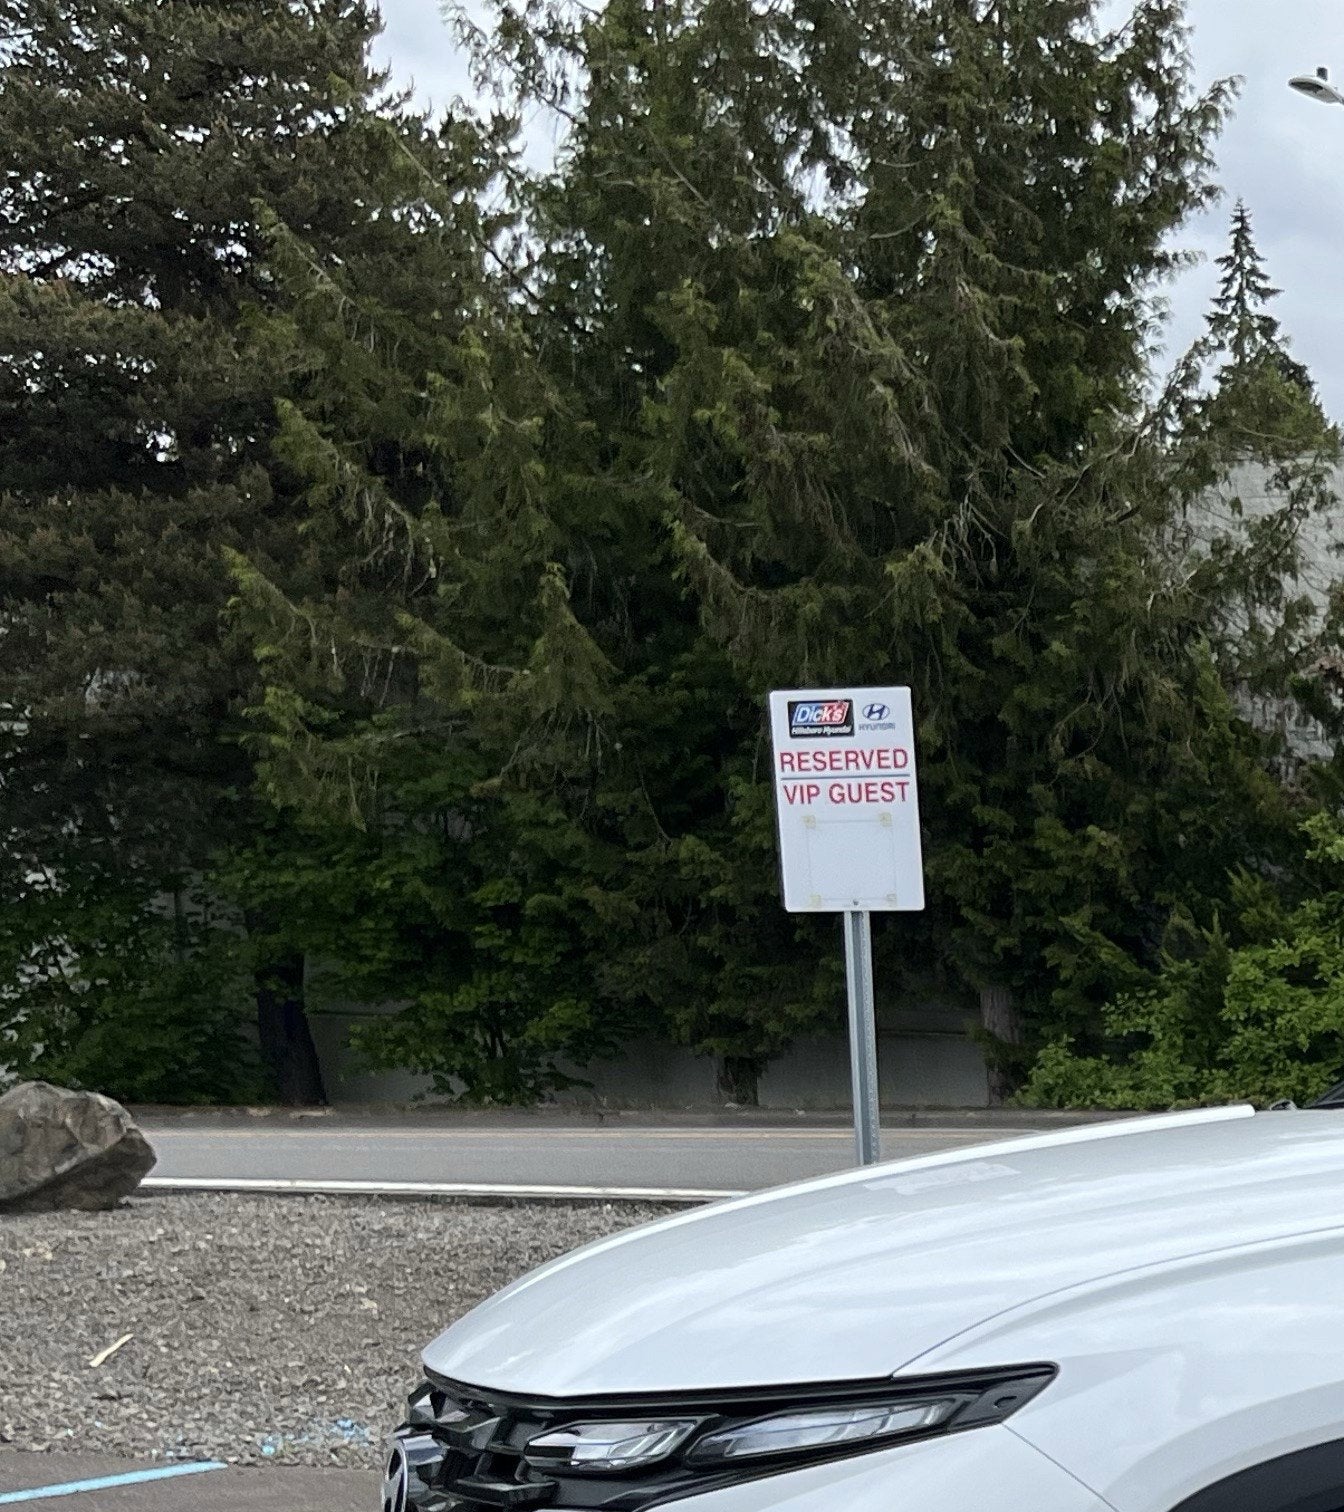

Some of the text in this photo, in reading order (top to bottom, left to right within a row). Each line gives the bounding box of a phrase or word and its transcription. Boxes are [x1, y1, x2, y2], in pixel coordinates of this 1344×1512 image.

[780, 748, 909, 772] RESERVED
[783, 781, 910, 805] VIP GUEST
